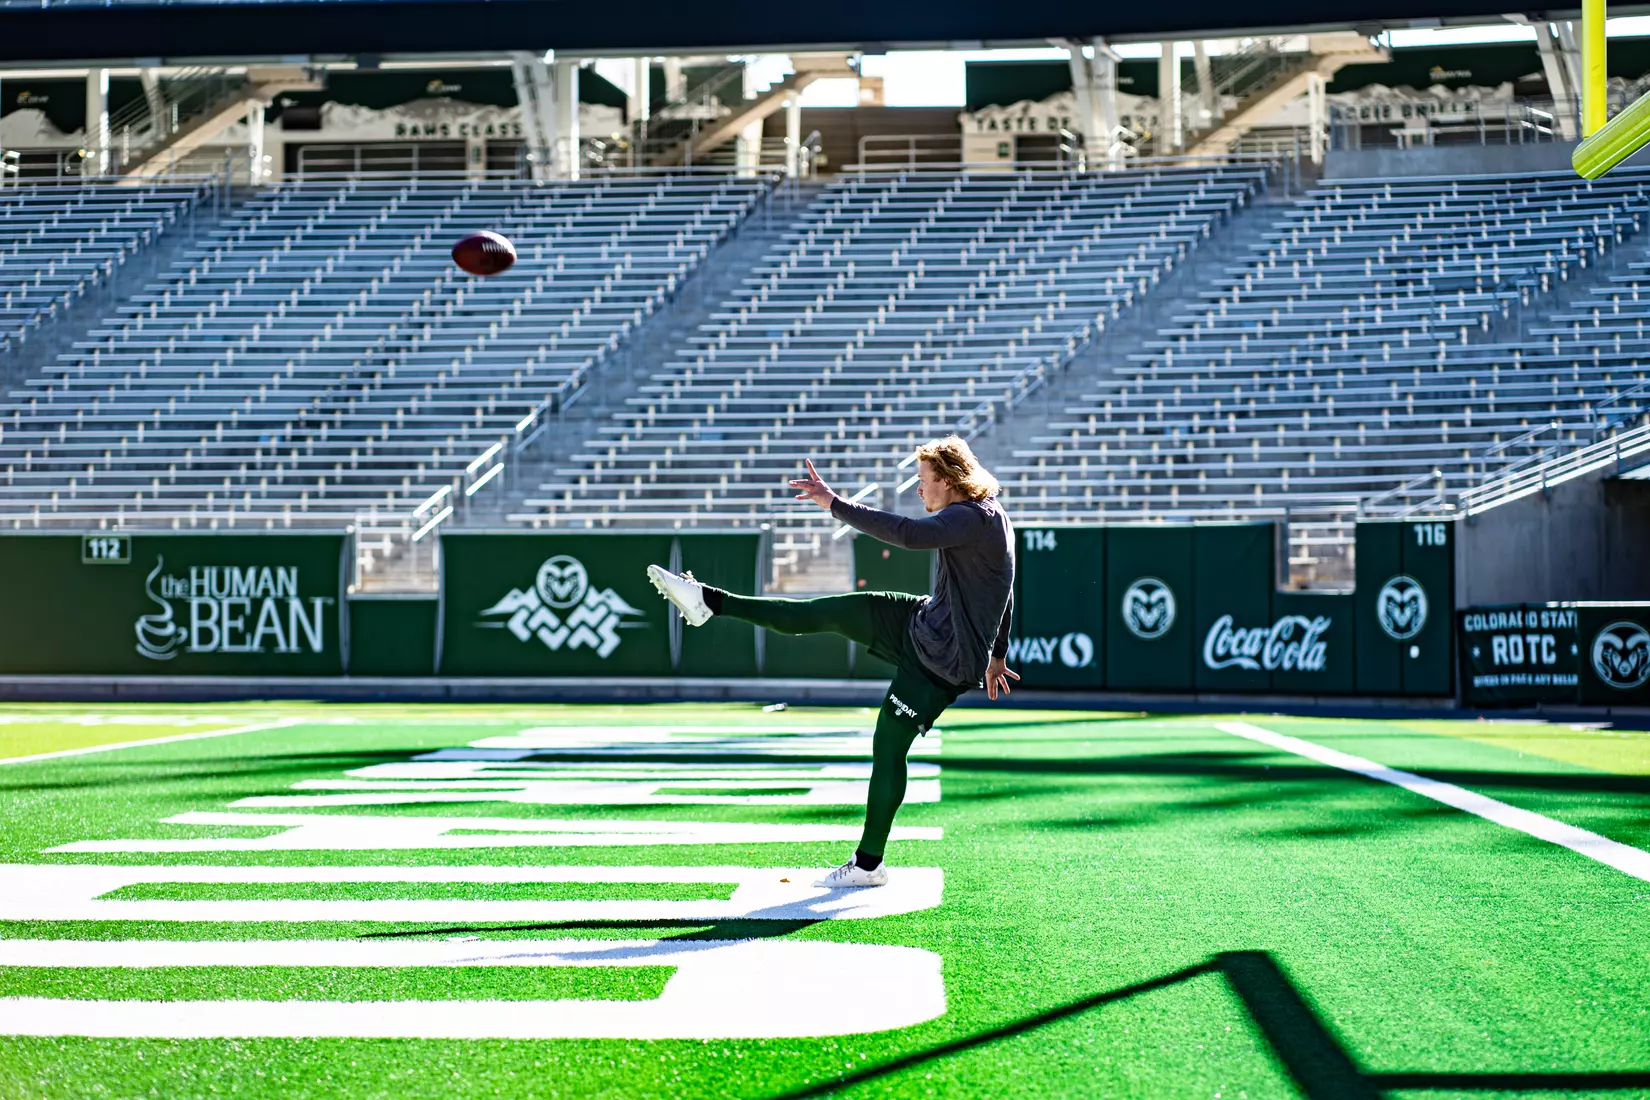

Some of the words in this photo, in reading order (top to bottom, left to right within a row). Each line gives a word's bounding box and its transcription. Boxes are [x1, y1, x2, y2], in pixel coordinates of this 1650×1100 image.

[395, 122, 449, 137] RAMS
[459, 122, 524, 138] CLASS
[977, 117, 1037, 132] TASTE
[1023, 530, 1057, 551] 114
[1414, 524, 1447, 546] 116
[89, 538, 120, 559] 112
[161, 574, 189, 598] the
[189, 566, 299, 598] HUMAN
[186, 597, 326, 653] BEAN
[1008, 636, 1058, 663] WAY
[1203, 614, 1332, 671] Coca-Cola
[1492, 634, 1557, 666] ROTC
